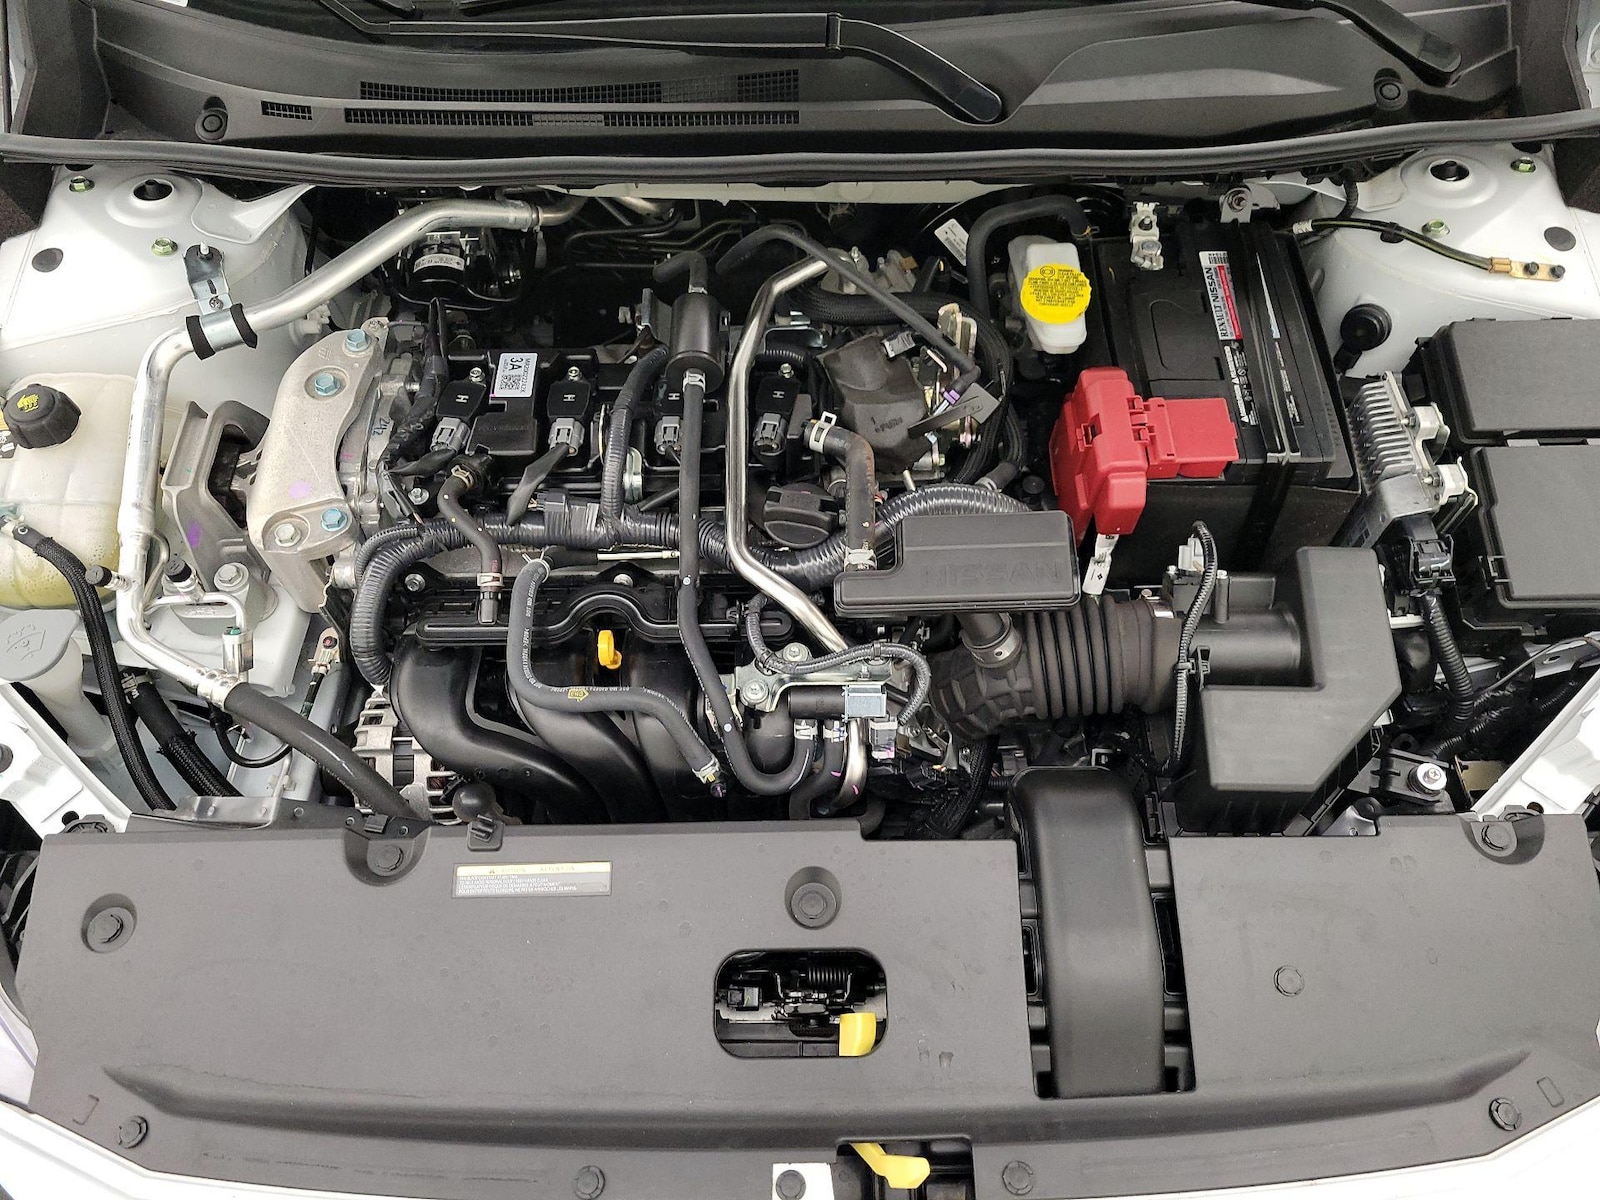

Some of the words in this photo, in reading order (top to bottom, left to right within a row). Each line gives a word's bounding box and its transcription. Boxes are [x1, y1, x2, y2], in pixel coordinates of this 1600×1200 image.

[1204, 267, 1219, 303] NISSAN
[1213, 304, 1229, 338] RENAULT
[508, 357, 524, 371] 3A
